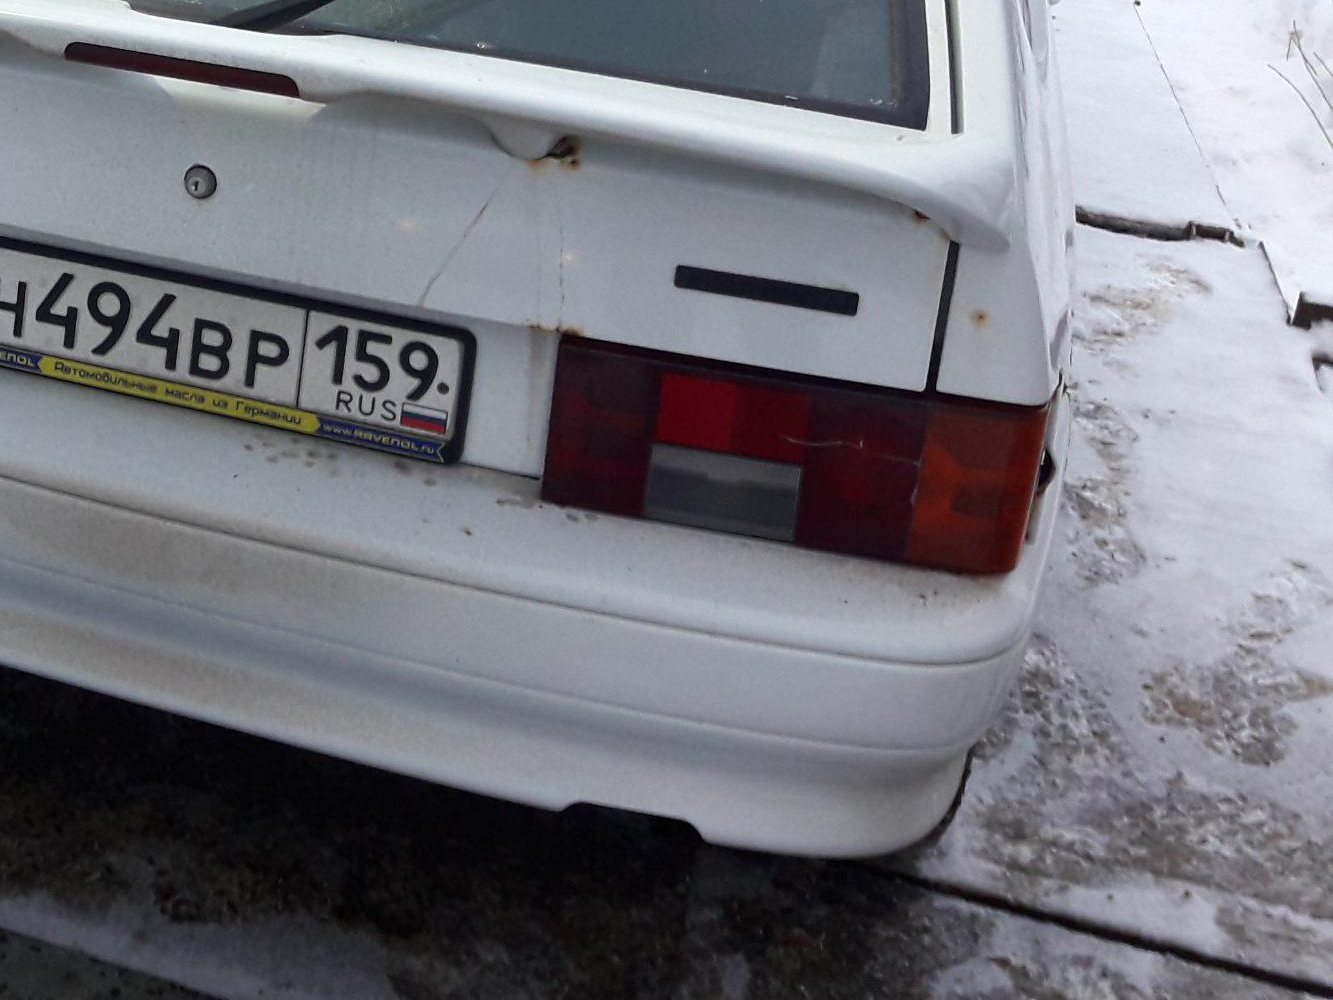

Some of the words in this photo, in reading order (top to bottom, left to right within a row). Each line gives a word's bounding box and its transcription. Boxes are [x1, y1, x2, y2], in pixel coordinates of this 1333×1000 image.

[53, 360, 158, 394] Автомобильные
[164, 386, 205, 404] масла
[212, 399, 229, 410] из
[235, 400, 302, 426] Германии
[315, 324, 440, 402] 159
[335, 389, 397, 422] RUS
